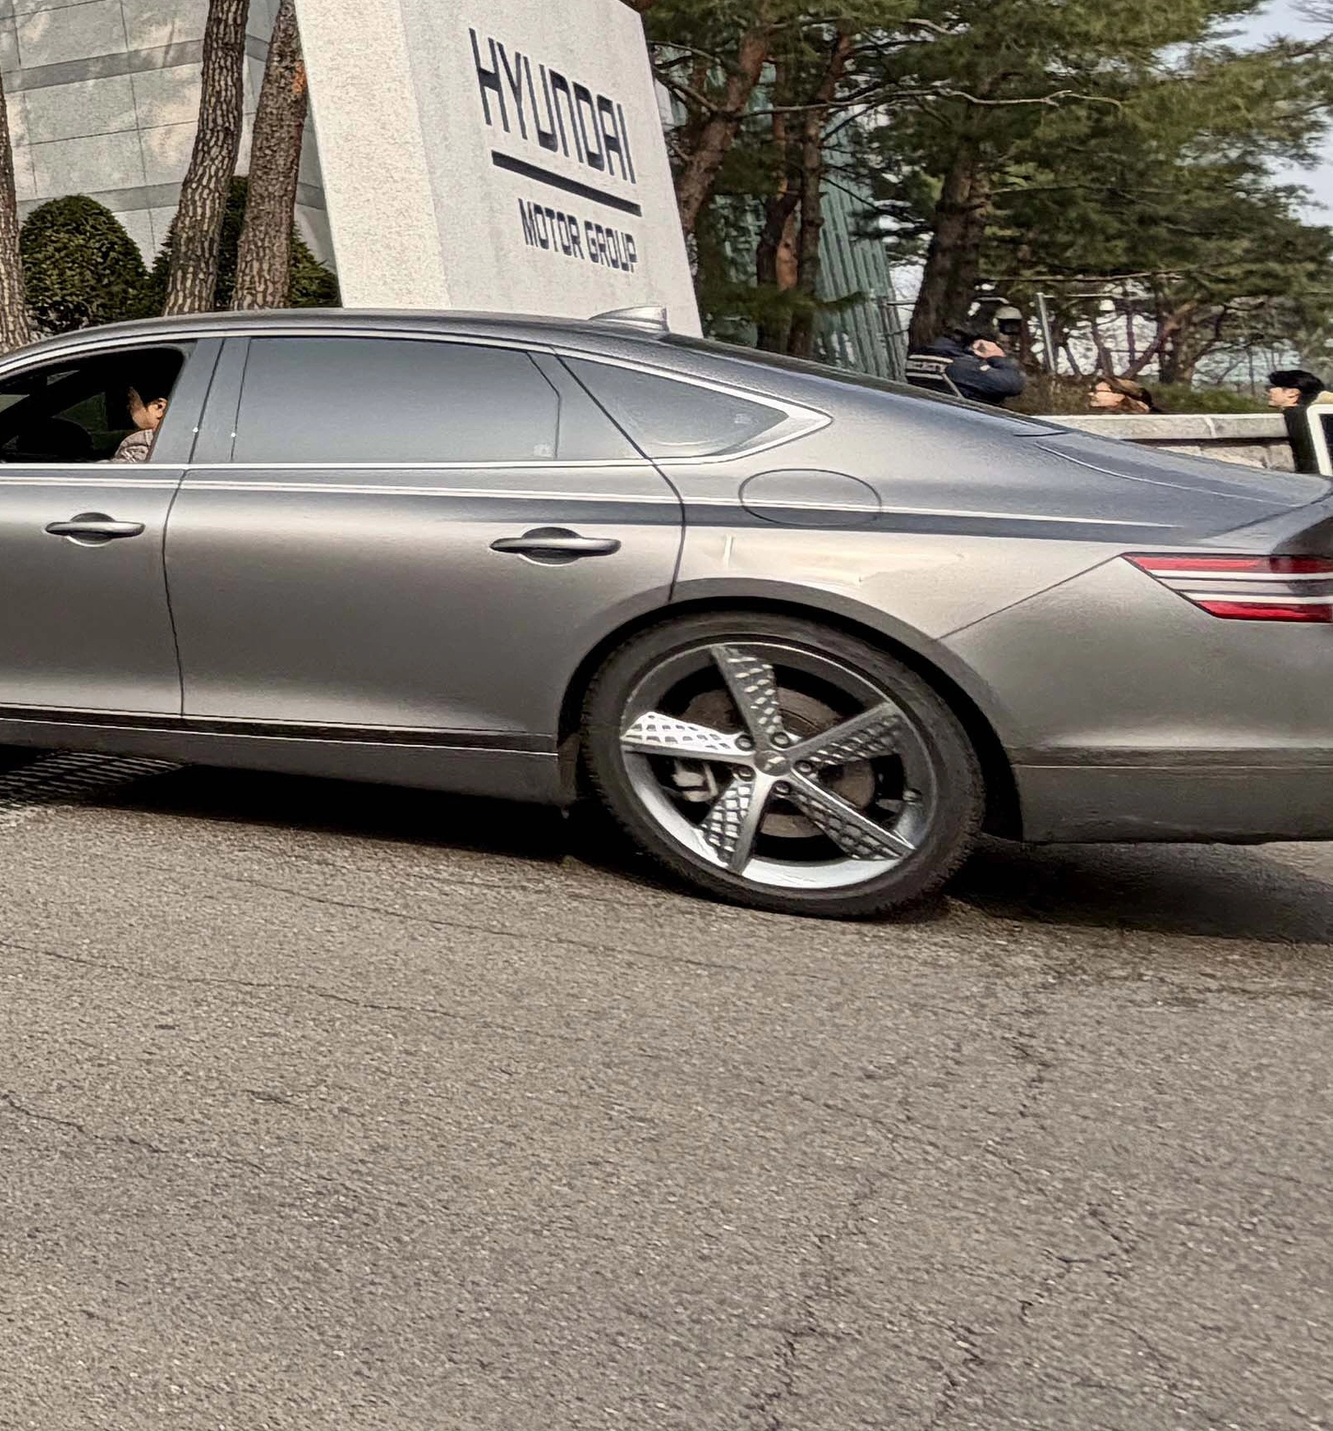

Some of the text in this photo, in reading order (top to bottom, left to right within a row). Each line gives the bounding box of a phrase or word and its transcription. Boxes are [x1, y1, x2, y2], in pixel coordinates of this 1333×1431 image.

[468, 28, 636, 185] HYUNDAI
[518, 198, 638, 273] MOTOR GROUP
